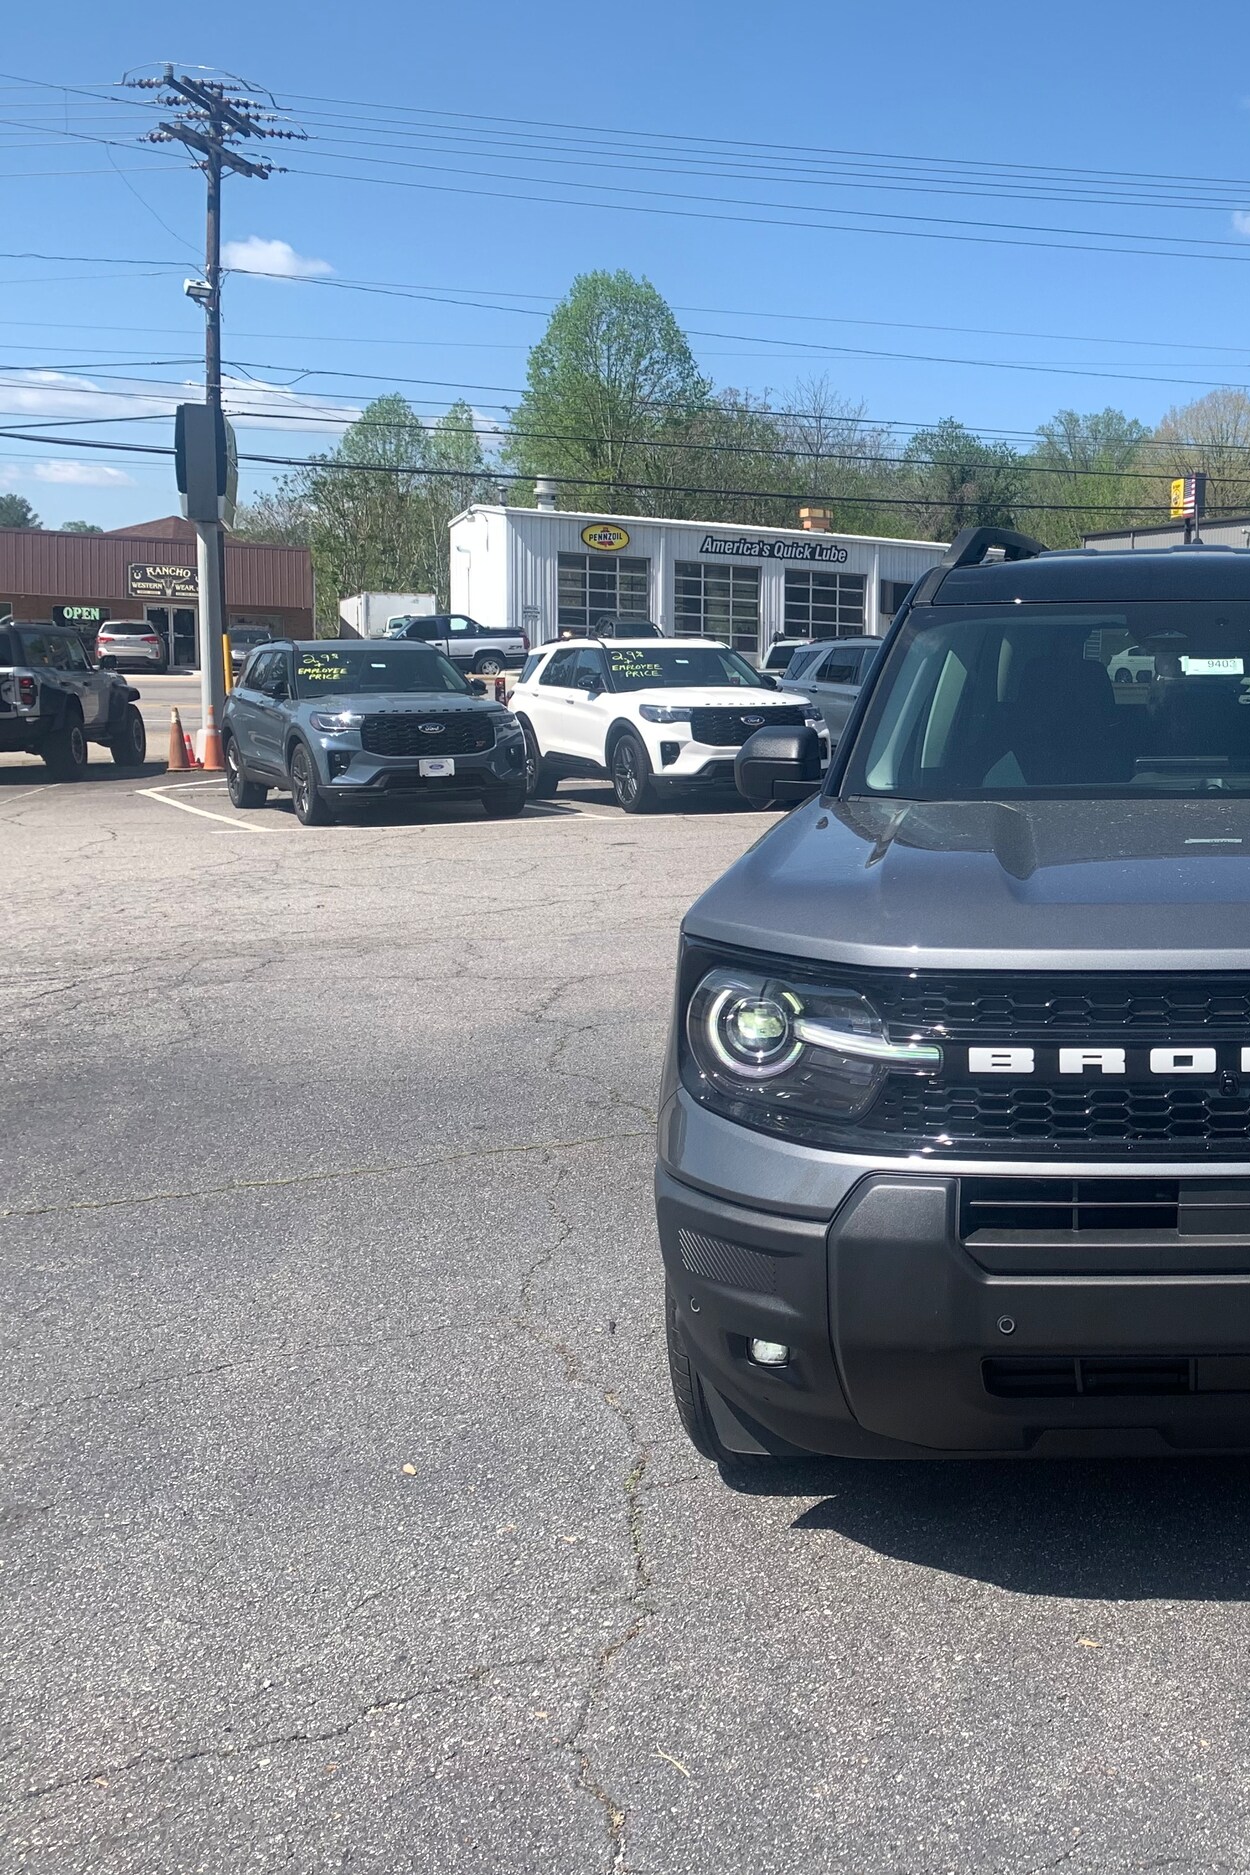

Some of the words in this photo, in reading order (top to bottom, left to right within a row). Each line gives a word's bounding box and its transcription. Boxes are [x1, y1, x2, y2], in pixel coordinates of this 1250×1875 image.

[588, 532, 623, 541] PENNZOIL
[702, 537, 771, 557] America's
[774, 542, 812, 559] Quick
[815, 545, 847, 562] Lube
[145, 566, 191, 578] RANCHO
[131, 581, 163, 590] WESTERN
[63, 606, 100, 620] OPEN
